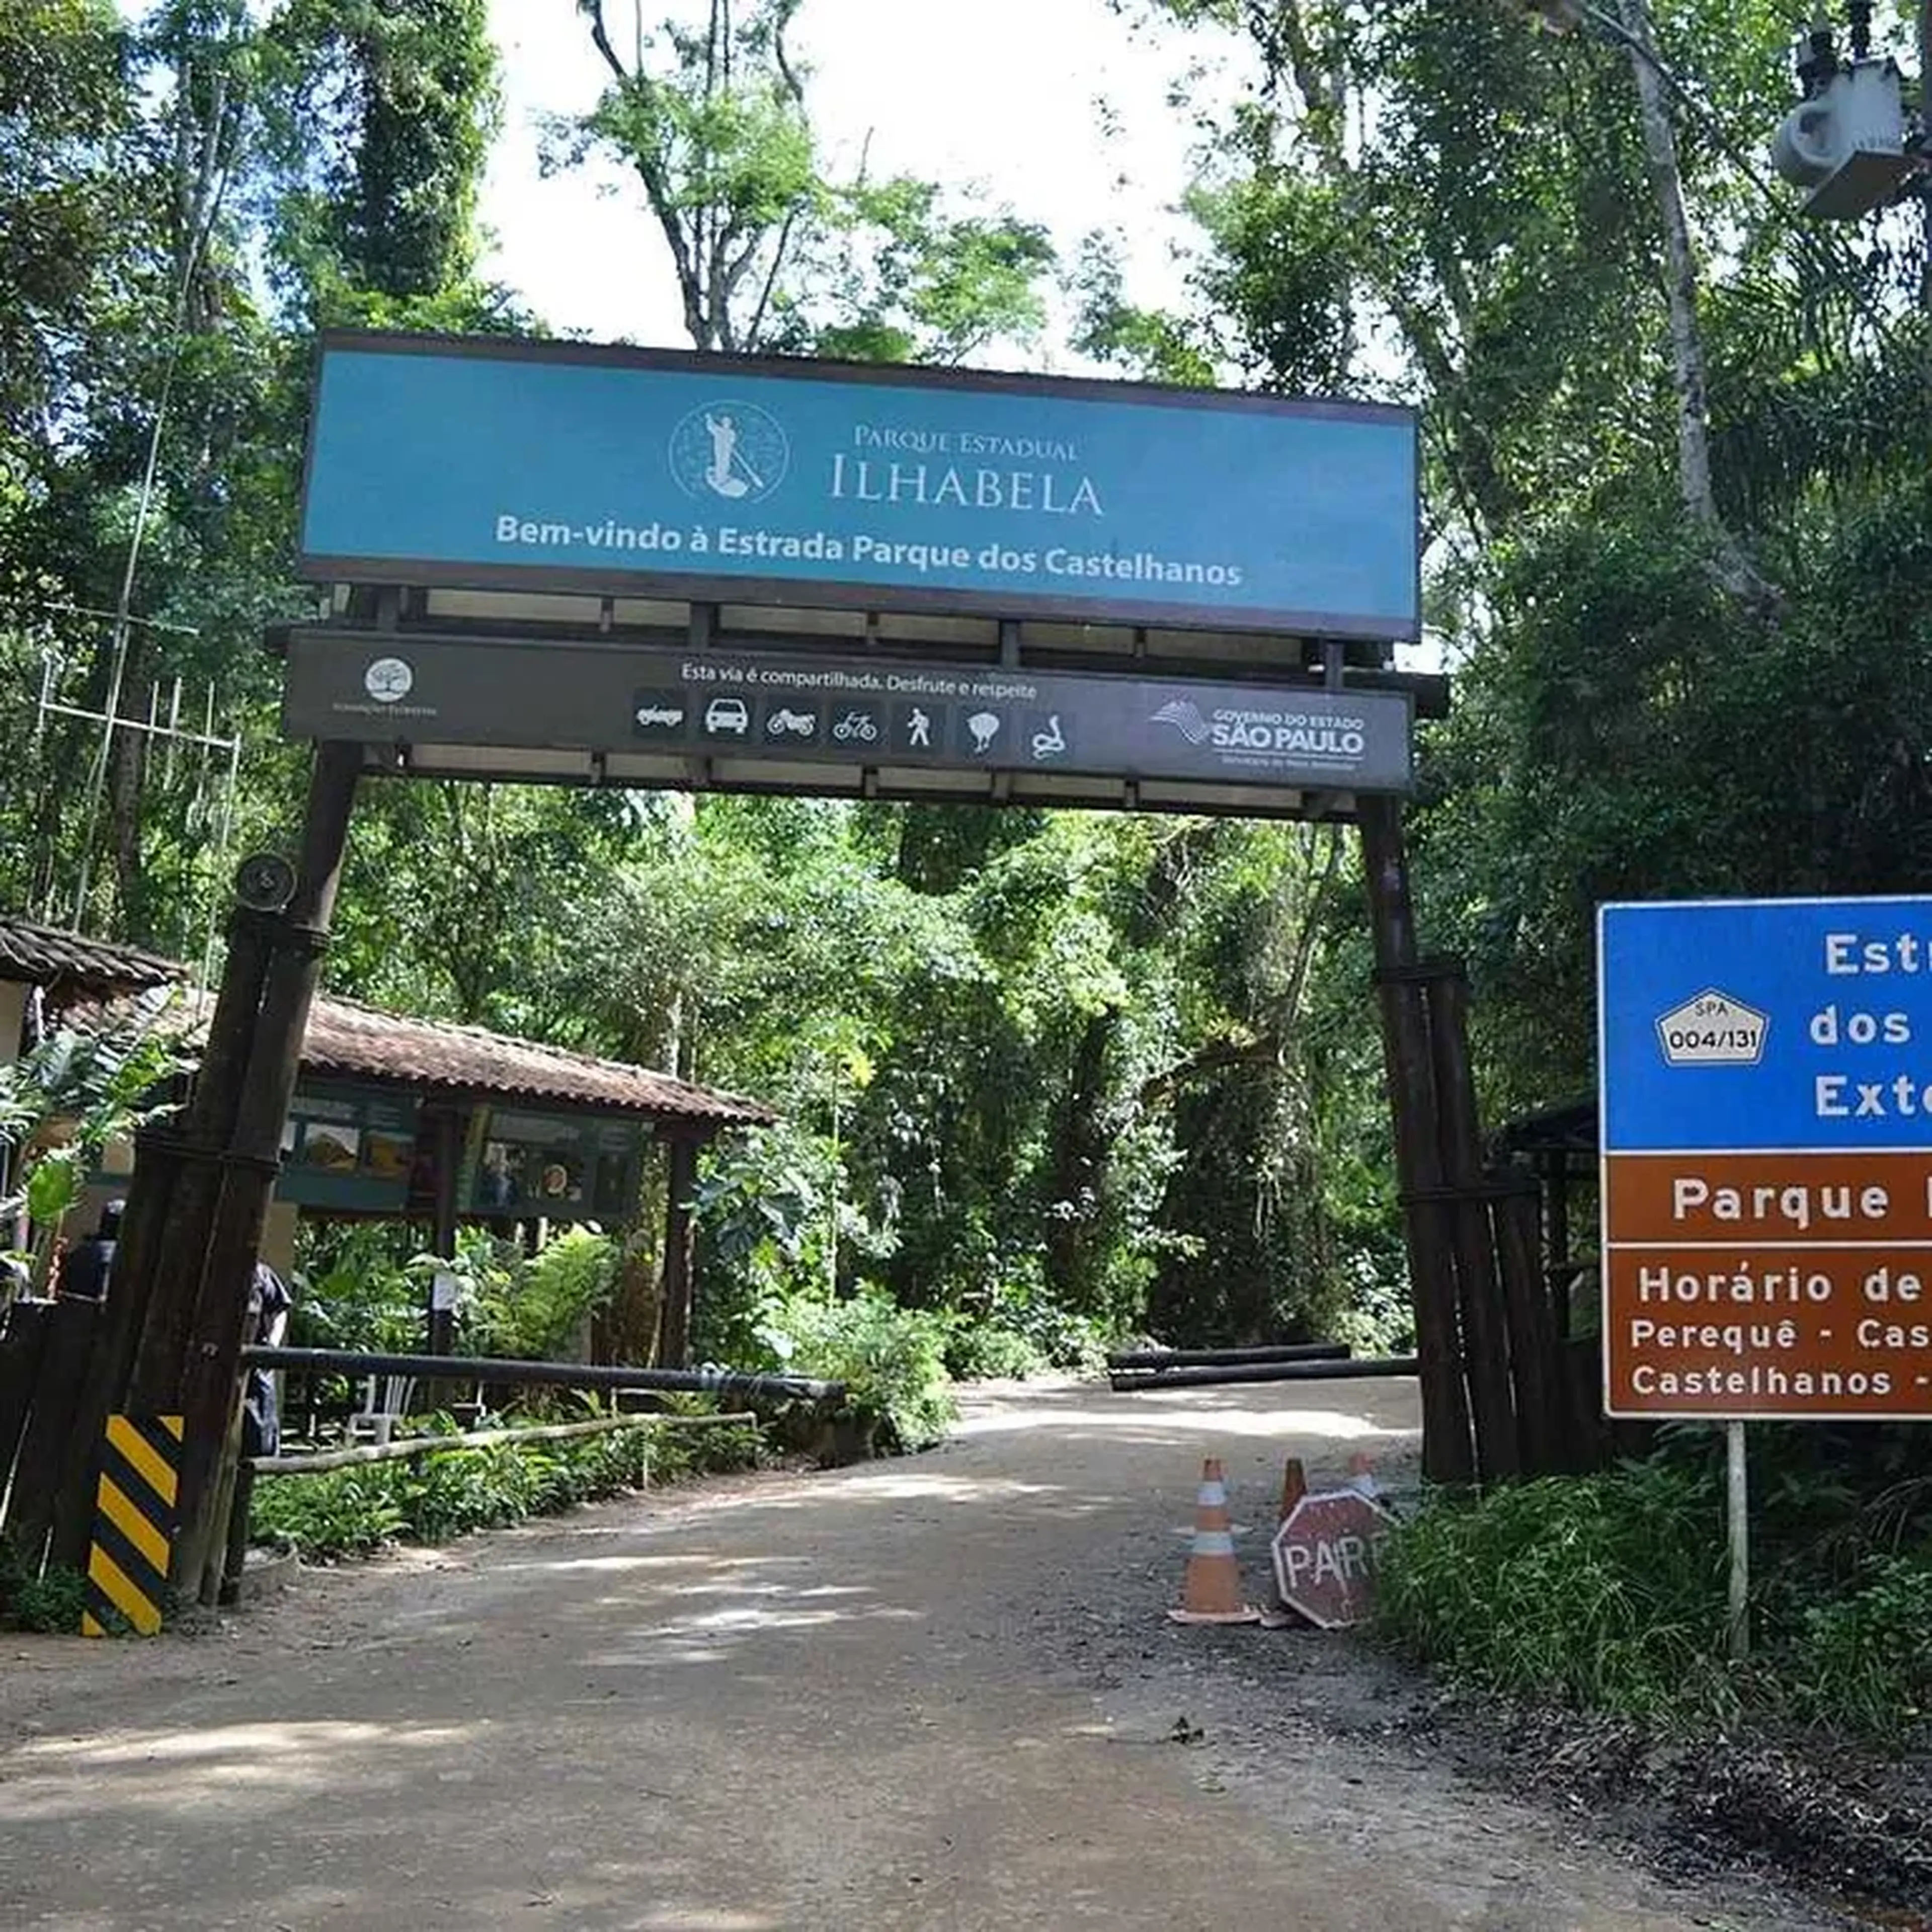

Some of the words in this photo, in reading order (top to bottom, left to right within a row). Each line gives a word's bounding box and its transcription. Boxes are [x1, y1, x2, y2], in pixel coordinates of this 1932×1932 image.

[855, 425, 951, 453] PARQUE
[959, 431, 1079, 461] ESTADUAL
[831, 453, 1105, 516] ILHABELA
[496, 515, 681, 551] Bem-vindo
[690, 525, 708, 552] à
[718, 527, 843, 560] Estrada
[852, 535, 971, 572] Parque
[979, 543, 1036, 573] dos
[1044, 547, 1243, 585] Castelhanos
[681, 663, 716, 680] Esta
[719, 666, 744, 682] via
[746, 668, 757, 683] é
[760, 670, 884, 690] compartilhada.
[887, 674, 955, 695] Desfrute
[958, 682, 970, 695] e
[972, 682, 1037, 700] respeite
[1212, 719, 1271, 748] SÃO
[1274, 728, 1364, 754] PAULO
[1213, 709, 1282, 725] GOVERNO
[1284, 713, 1307, 727] DO
[1309, 715, 1364, 731] ESTADO
[1825, 933, 1932, 975] Est
[1695, 1001, 1729, 1017] SPA
[1810, 1005, 1910, 1045] dos
[1669, 1029, 1757, 1049] 004/131
[1673, 1178, 1889, 1231] Parque
[1639, 1260, 1832, 1302] Horário
[1864, 1266, 1922, 1302] de
[1631, 1319, 1798, 1354] Perequê
[1632, 1365, 1892, 1395] Castelhanos
